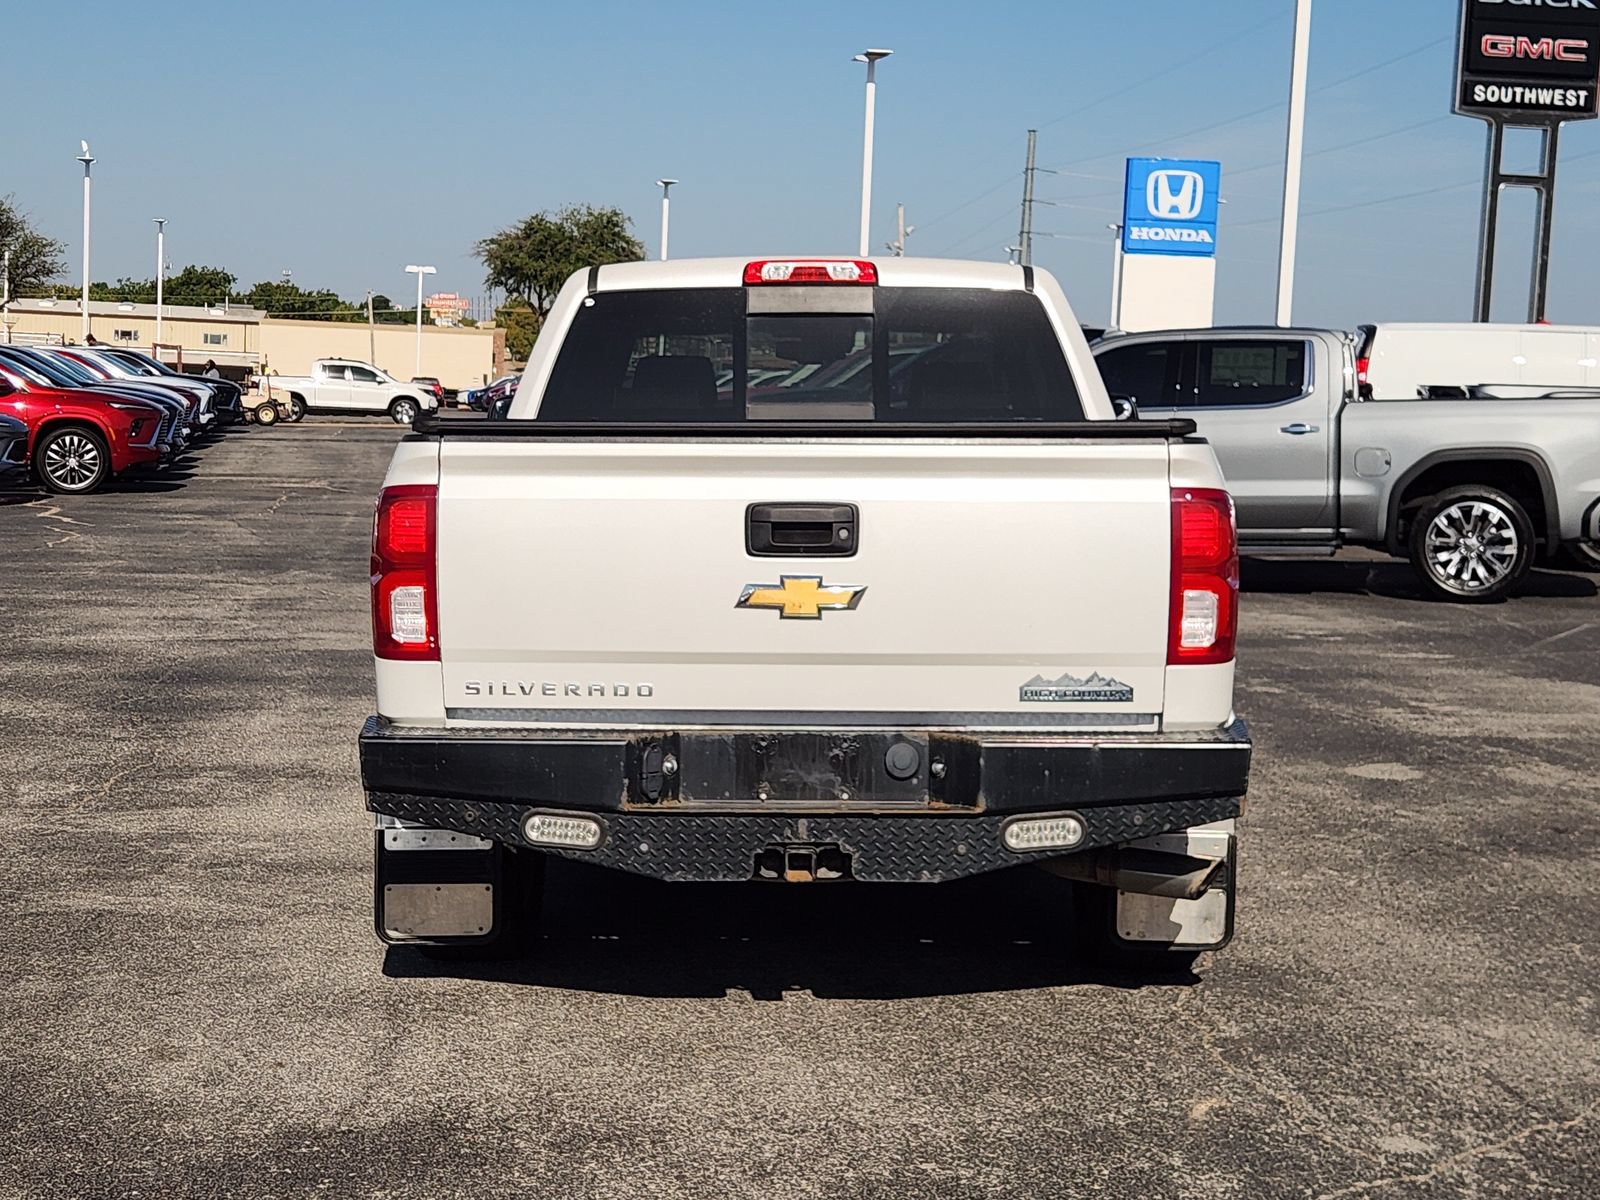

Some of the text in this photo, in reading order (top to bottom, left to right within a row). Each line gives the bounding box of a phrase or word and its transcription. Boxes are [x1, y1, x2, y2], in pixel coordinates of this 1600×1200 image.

[1481, 34, 1588, 61] GMC
[1473, 84, 1589, 107] SOUTHWEST
[1129, 226, 1213, 243] HONDA
[465, 681, 653, 697] SILVERADO
